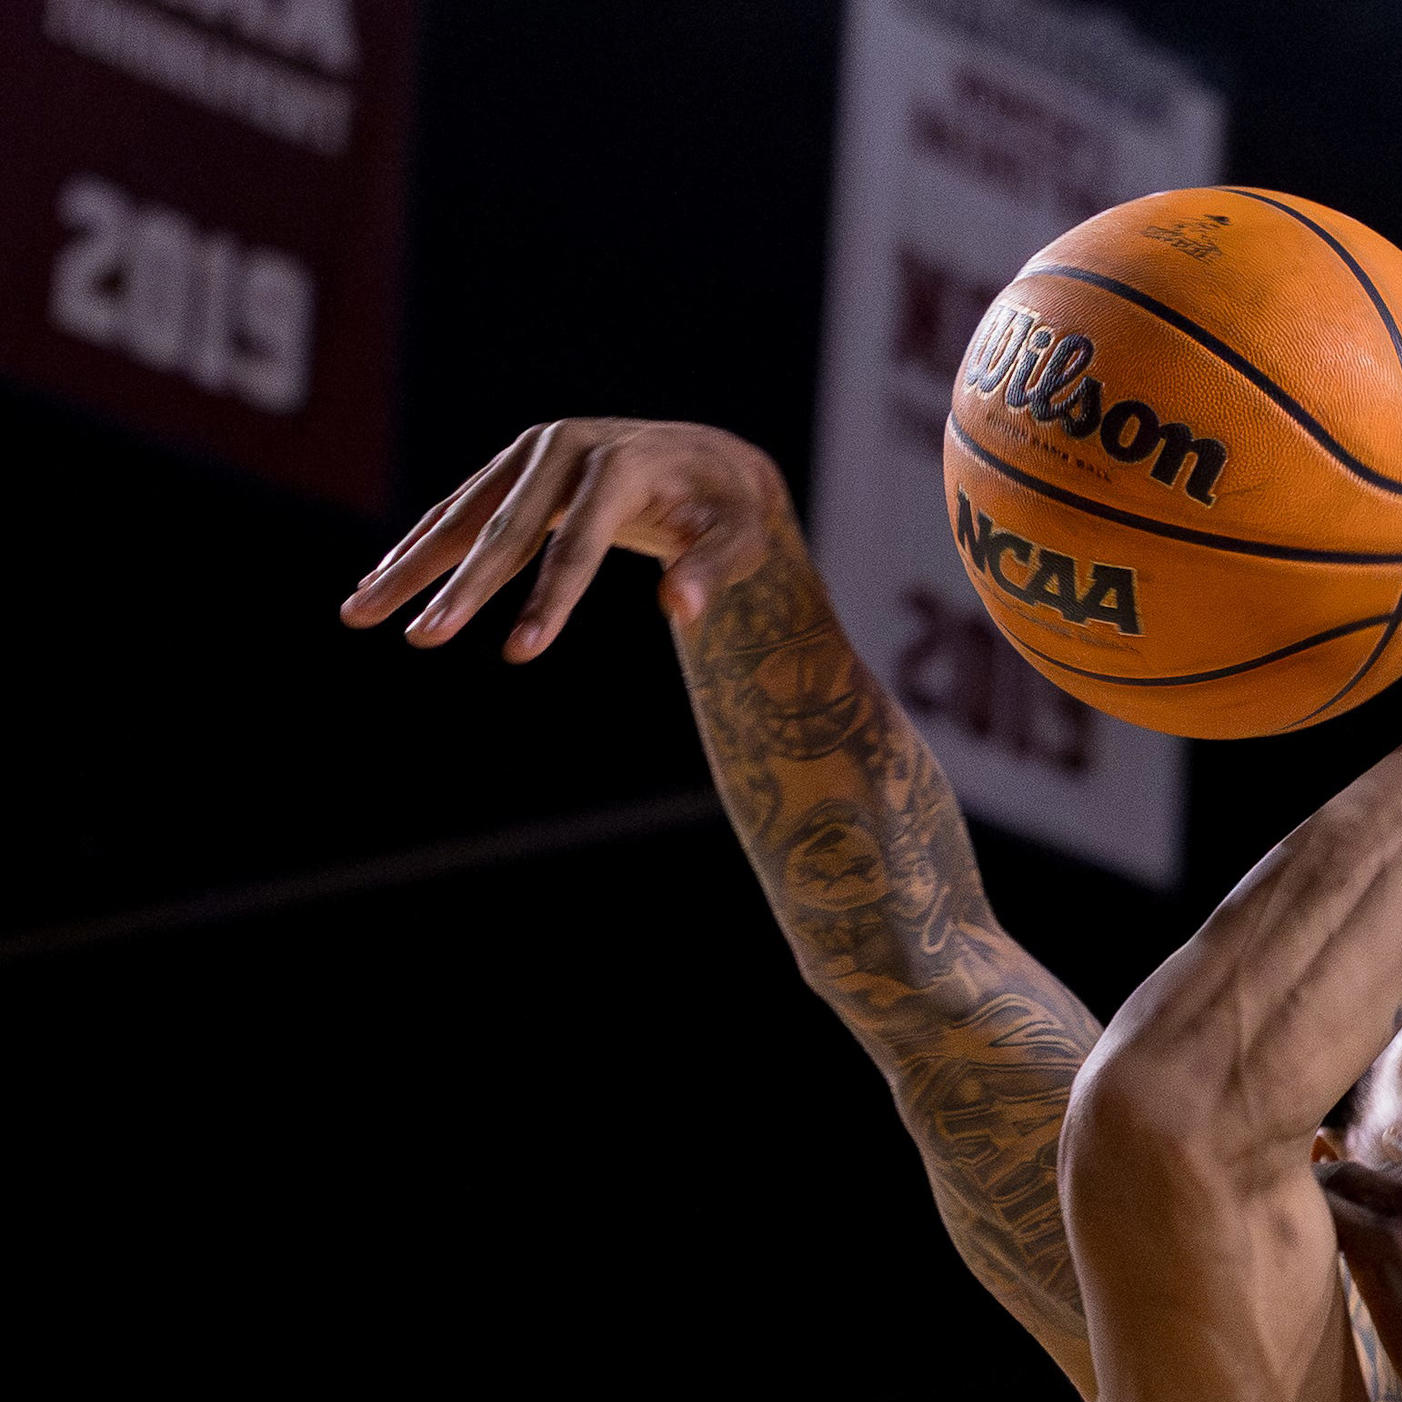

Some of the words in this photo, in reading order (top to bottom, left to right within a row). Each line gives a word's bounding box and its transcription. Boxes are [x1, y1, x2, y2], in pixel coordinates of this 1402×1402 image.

[47, 172, 318, 417] 2019
[964, 303, 1228, 508] Wilson
[957, 484, 1147, 638] NCAA
